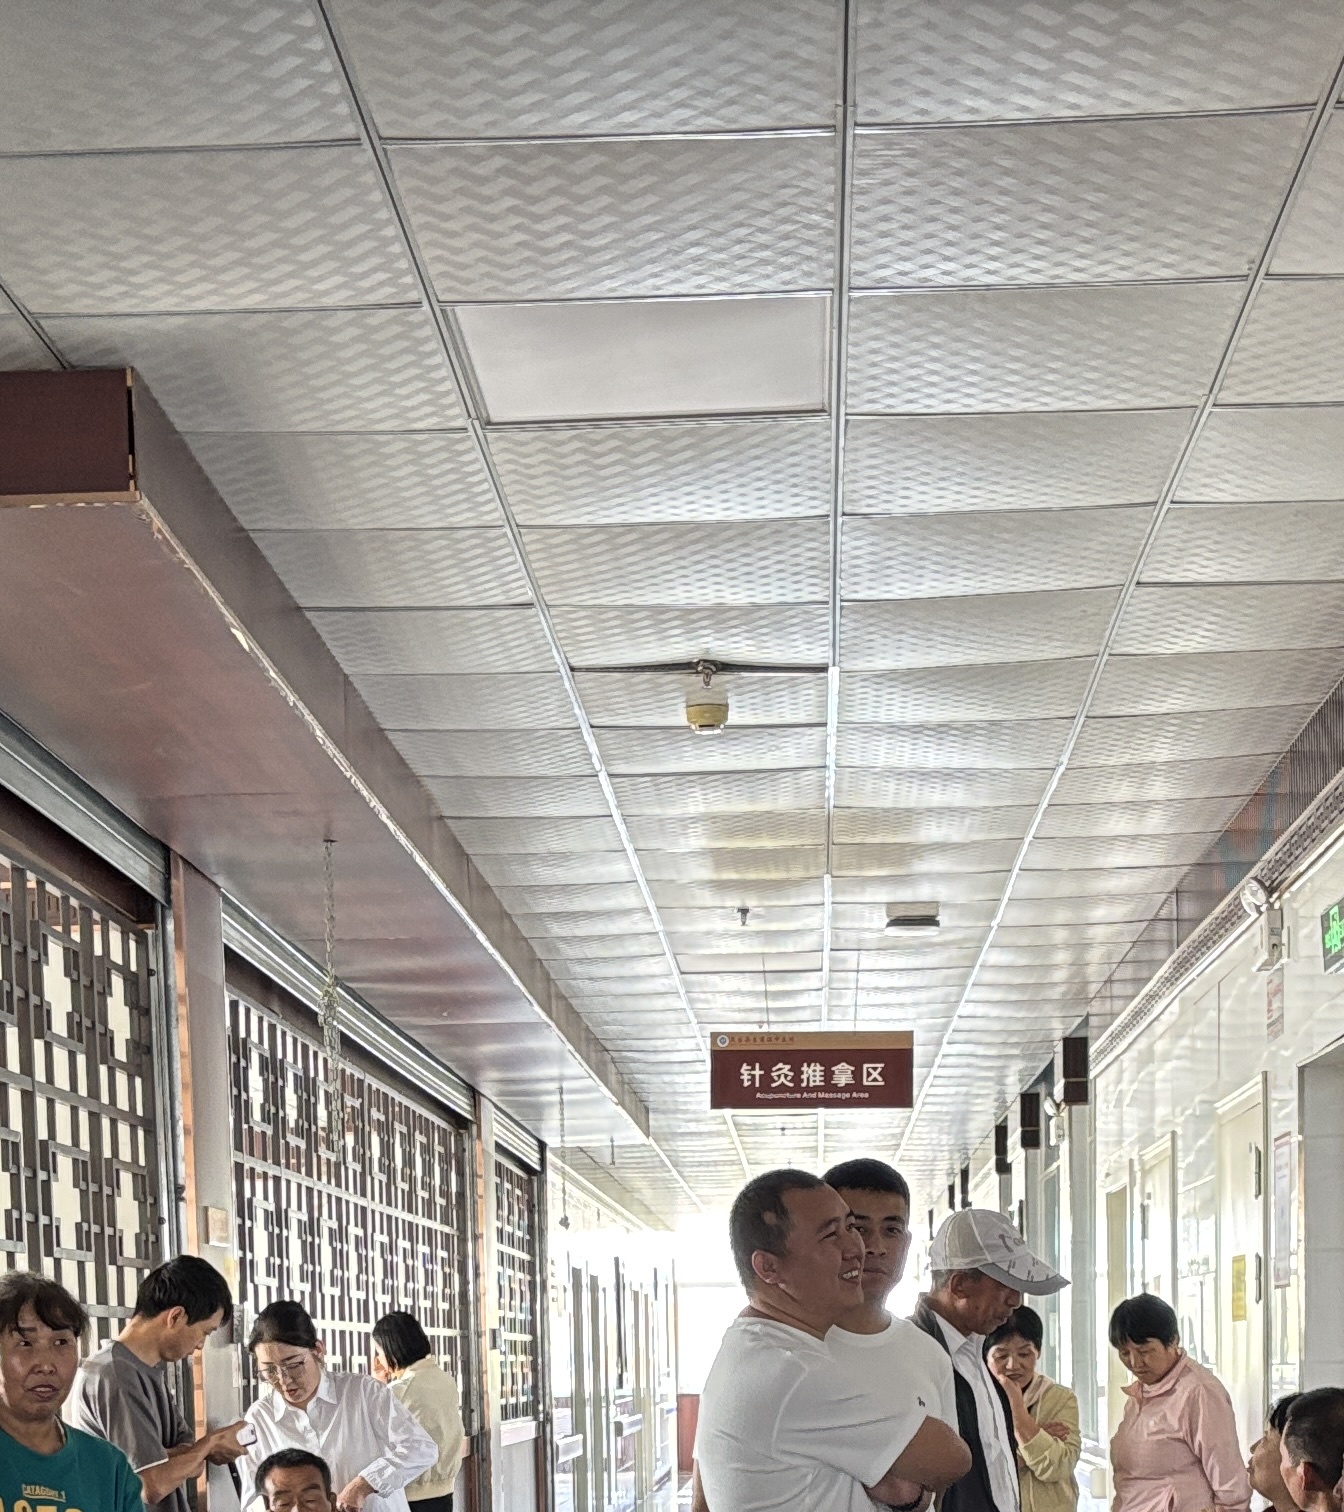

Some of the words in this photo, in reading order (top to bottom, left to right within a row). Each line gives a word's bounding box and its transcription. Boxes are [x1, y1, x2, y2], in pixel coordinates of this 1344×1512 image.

[739, 1061, 886, 1088] 针灸推拿区
